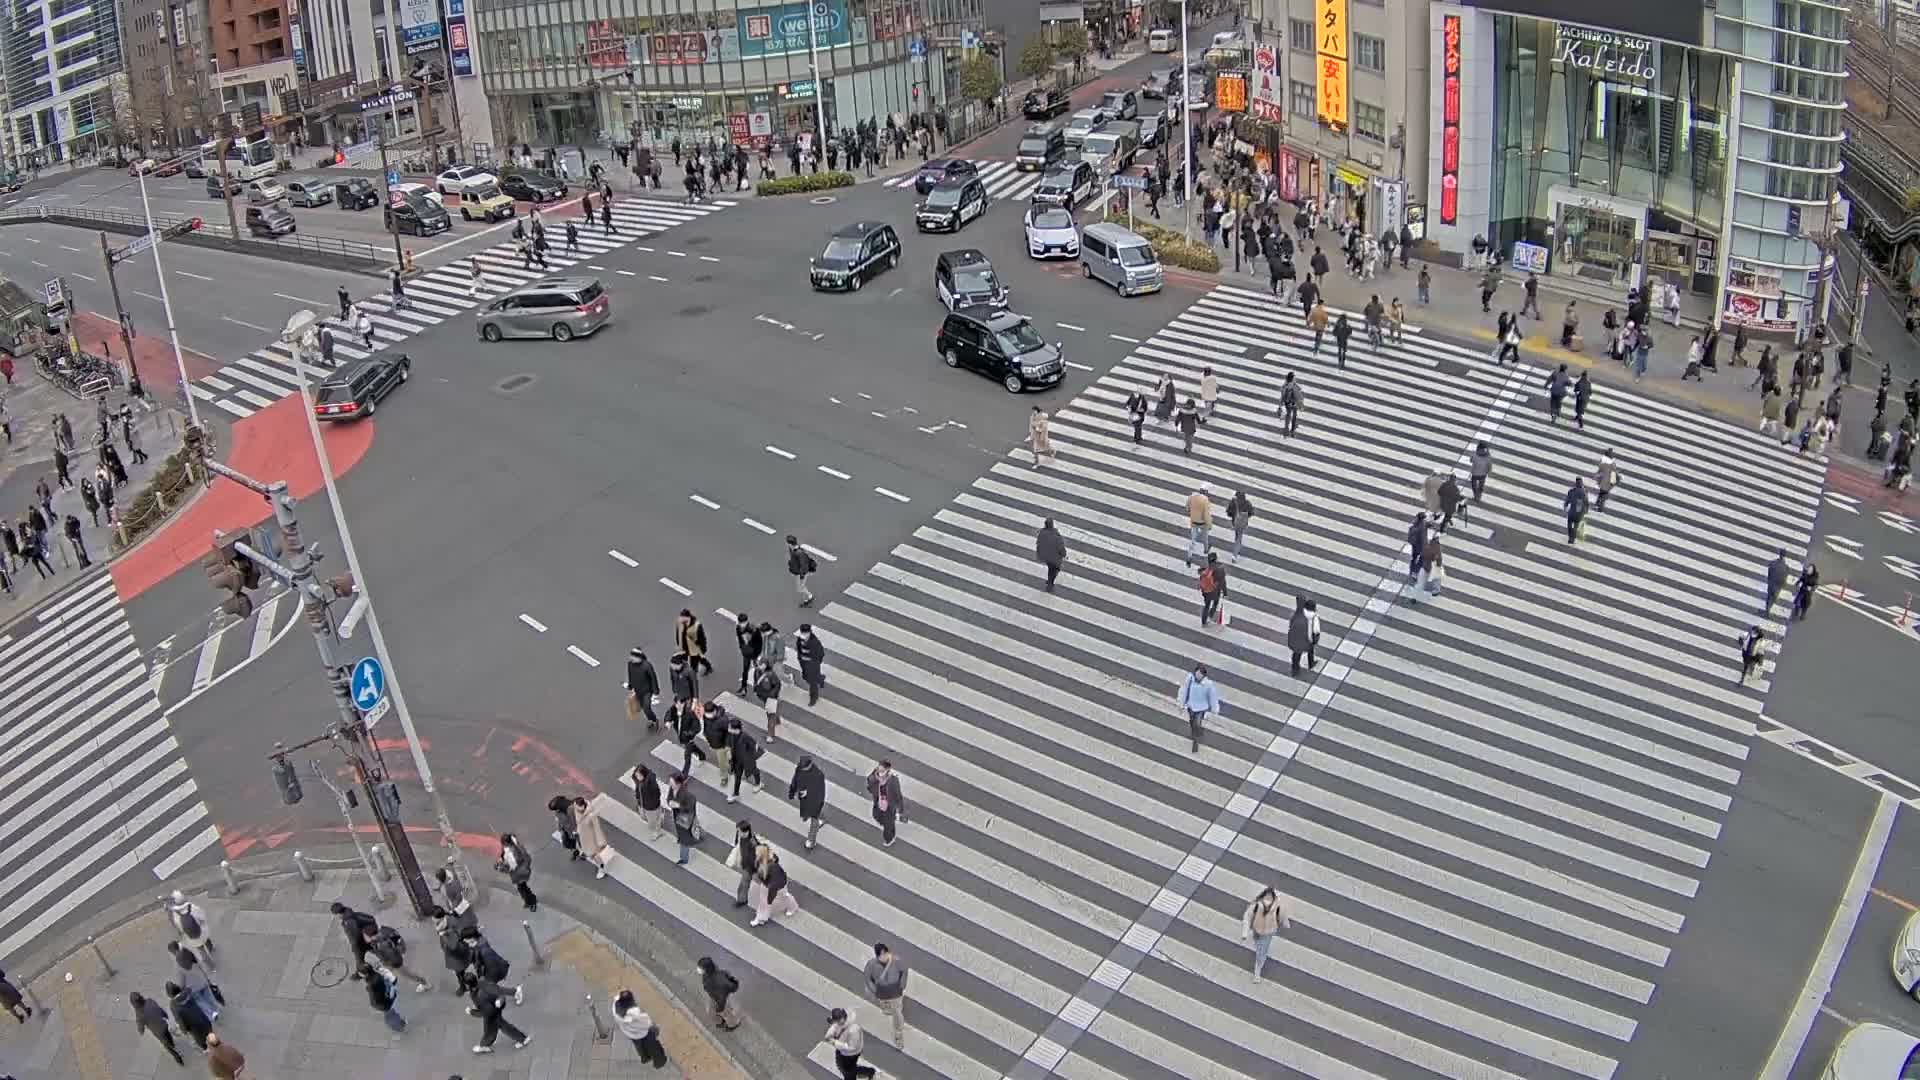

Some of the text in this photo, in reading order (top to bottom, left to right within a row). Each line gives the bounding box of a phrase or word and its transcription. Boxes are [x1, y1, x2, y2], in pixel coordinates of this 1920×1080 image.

[1323, 0, 1339, 52] タバ
[1556, 26, 1612, 44] PACHINKO
[1624, 37, 1652, 51] SLOT
[1550, 38, 1656, 79] Kaleido
